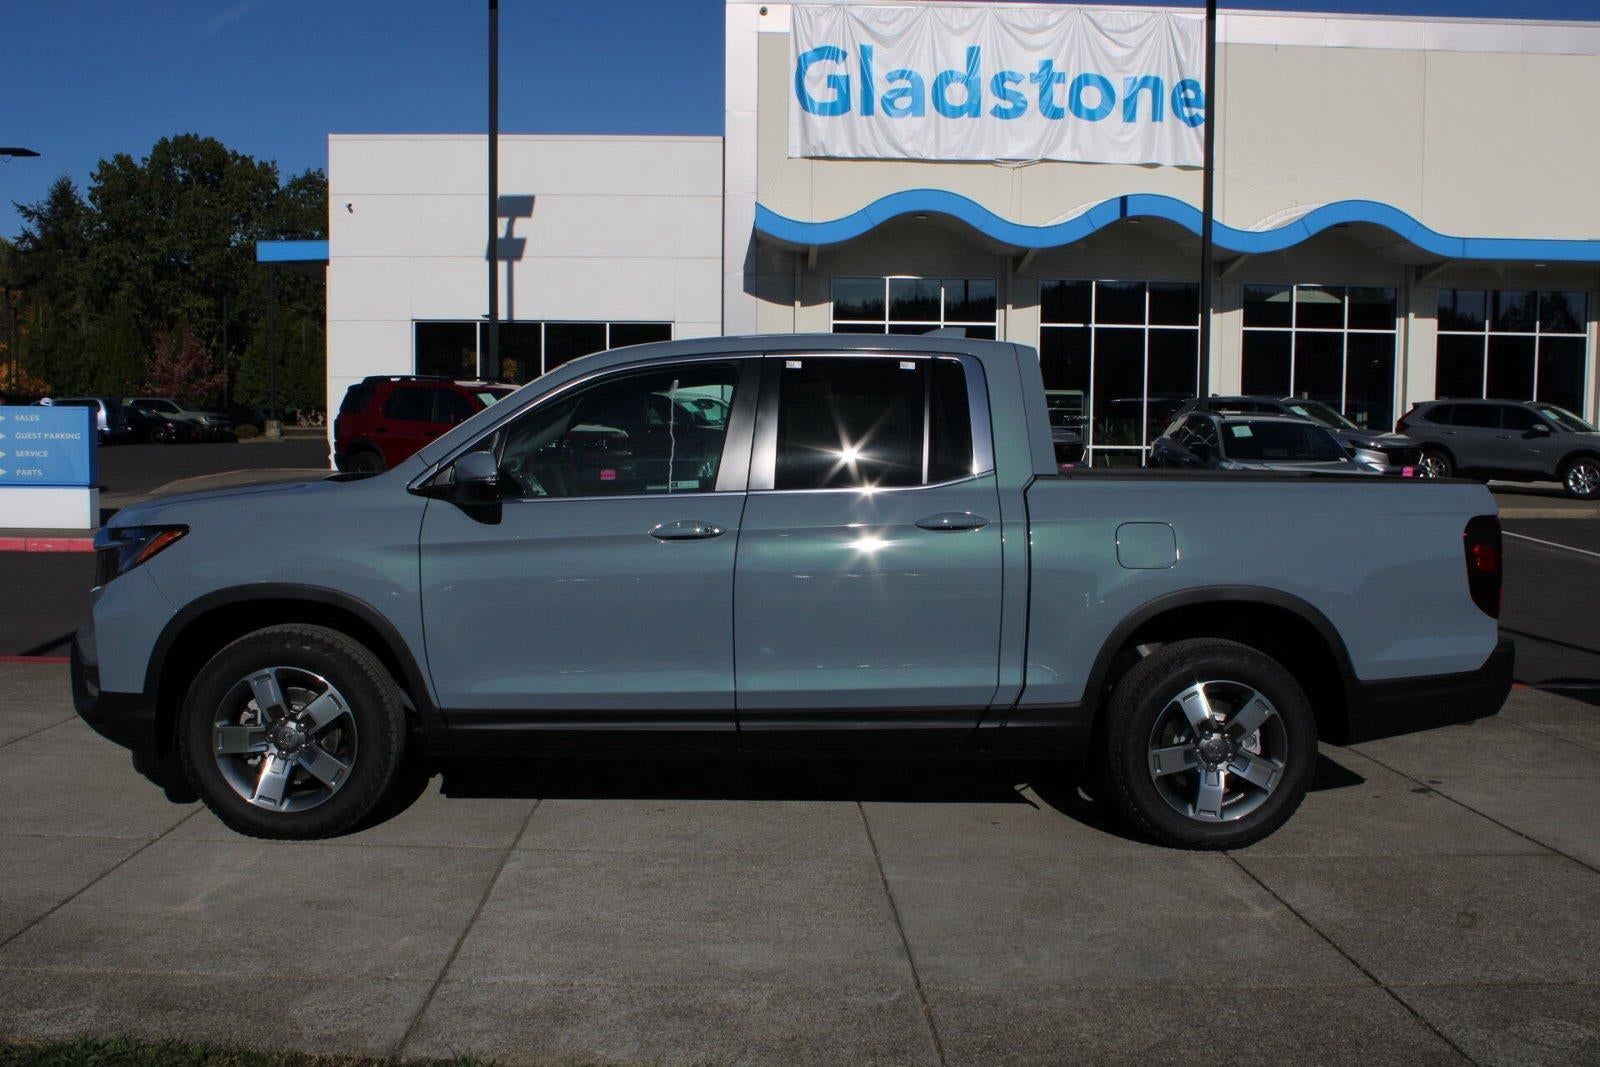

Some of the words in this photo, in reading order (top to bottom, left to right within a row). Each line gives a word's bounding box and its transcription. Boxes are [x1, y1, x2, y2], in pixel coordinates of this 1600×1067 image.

[794, 44, 1205, 128] Gladstone
[15, 432, 42, 440] GUEST
[44, 432, 81, 440] PARKING
[15, 450, 49, 458] SERVICE
